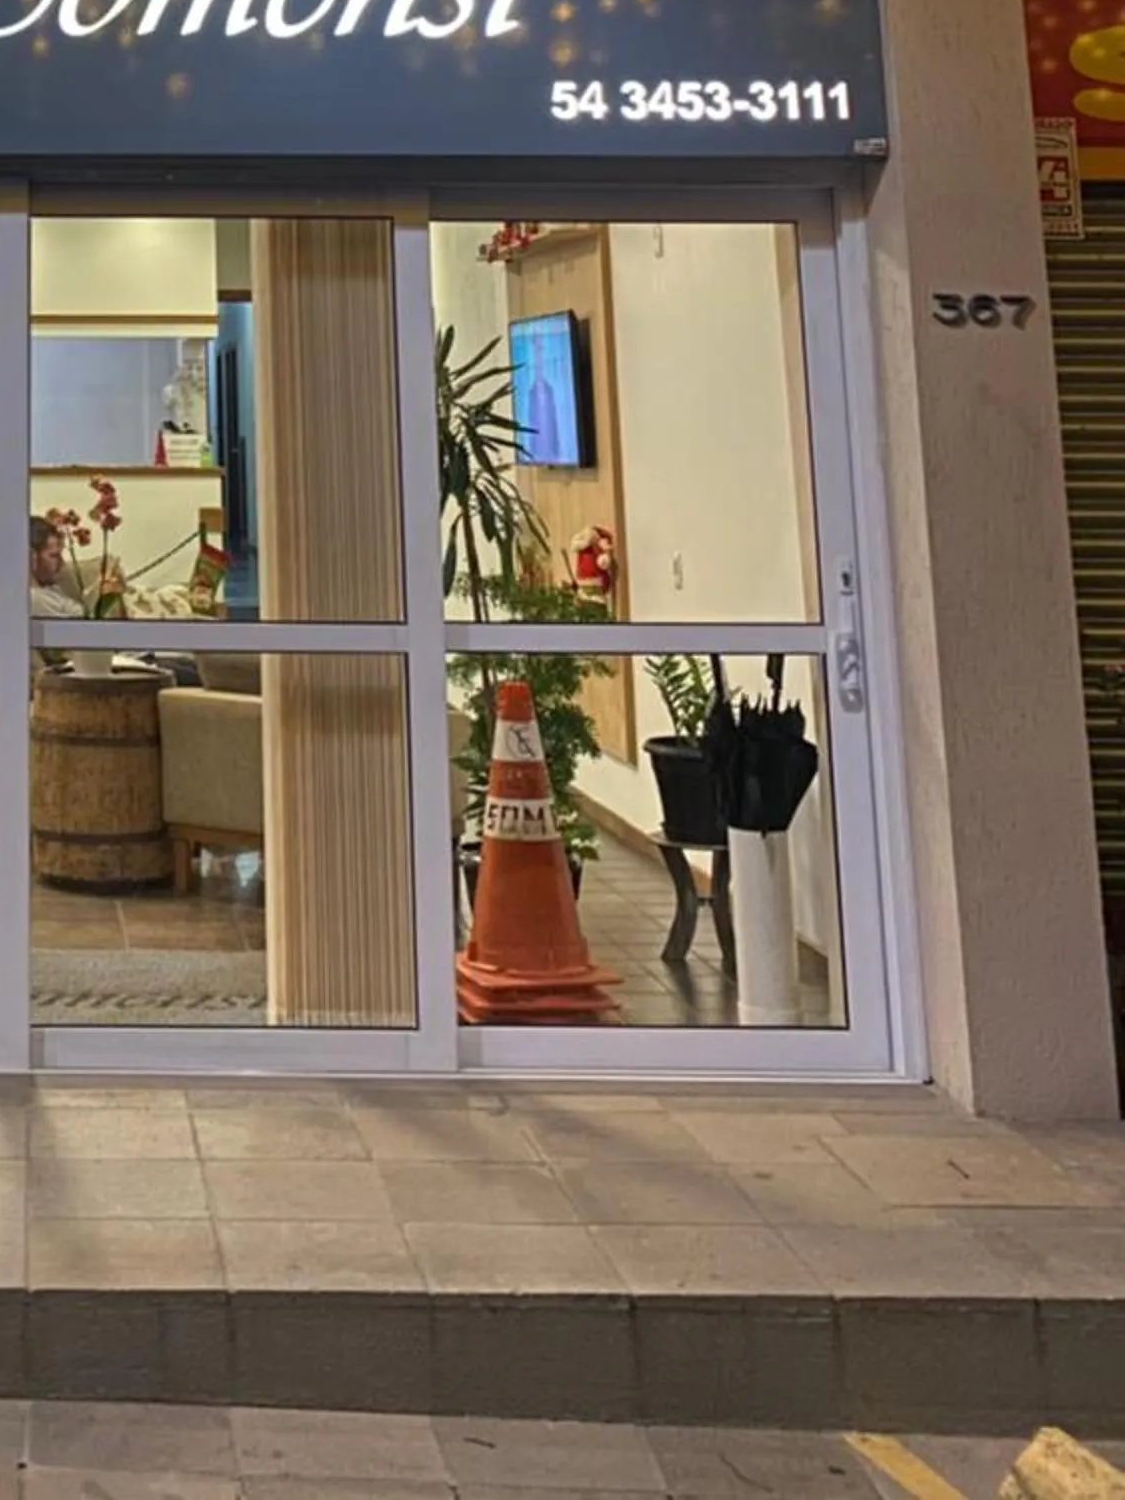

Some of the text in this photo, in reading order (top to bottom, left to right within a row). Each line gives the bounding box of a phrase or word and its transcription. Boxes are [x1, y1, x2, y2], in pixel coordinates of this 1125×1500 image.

[550, 80, 850, 121] 54 3453-3111
[932, 293, 1037, 332] 367
